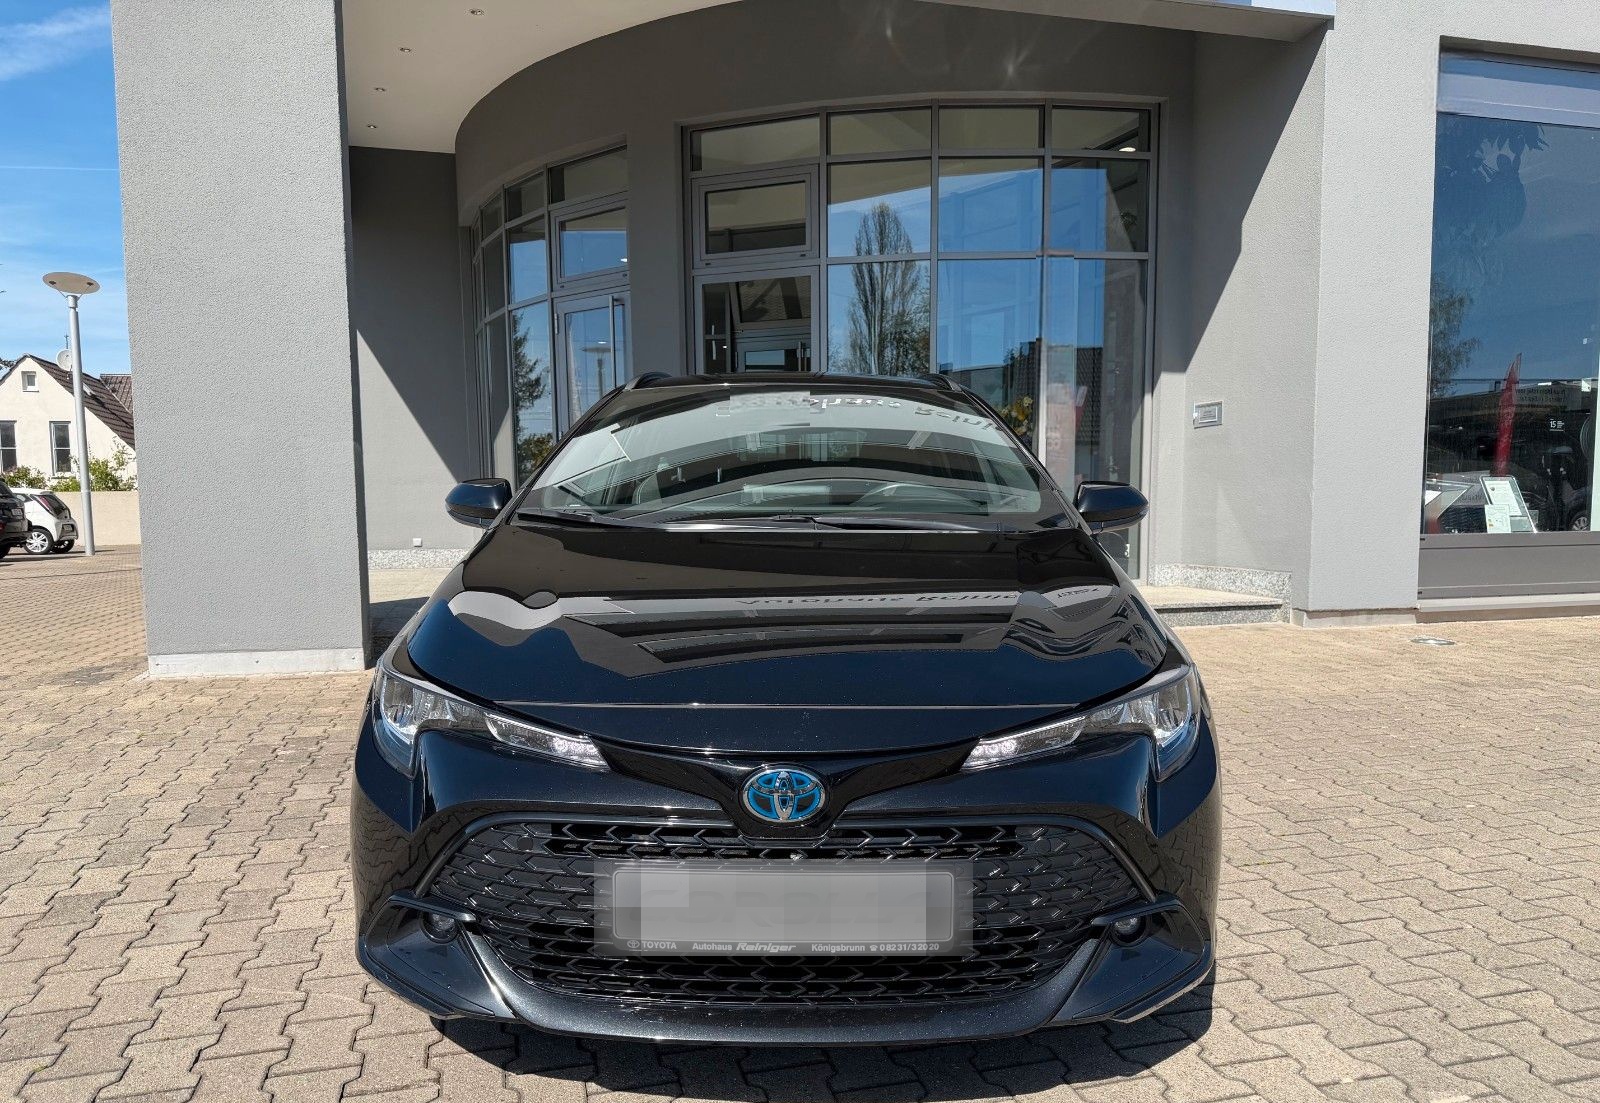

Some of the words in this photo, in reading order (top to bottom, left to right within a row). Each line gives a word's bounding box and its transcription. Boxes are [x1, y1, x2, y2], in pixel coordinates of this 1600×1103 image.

[642, 942, 677, 950] TOYOTA
[692, 942, 733, 951] Autohaus
[736, 942, 796, 953] Reiniger
[811, 943, 866, 953] Königsbrunn
